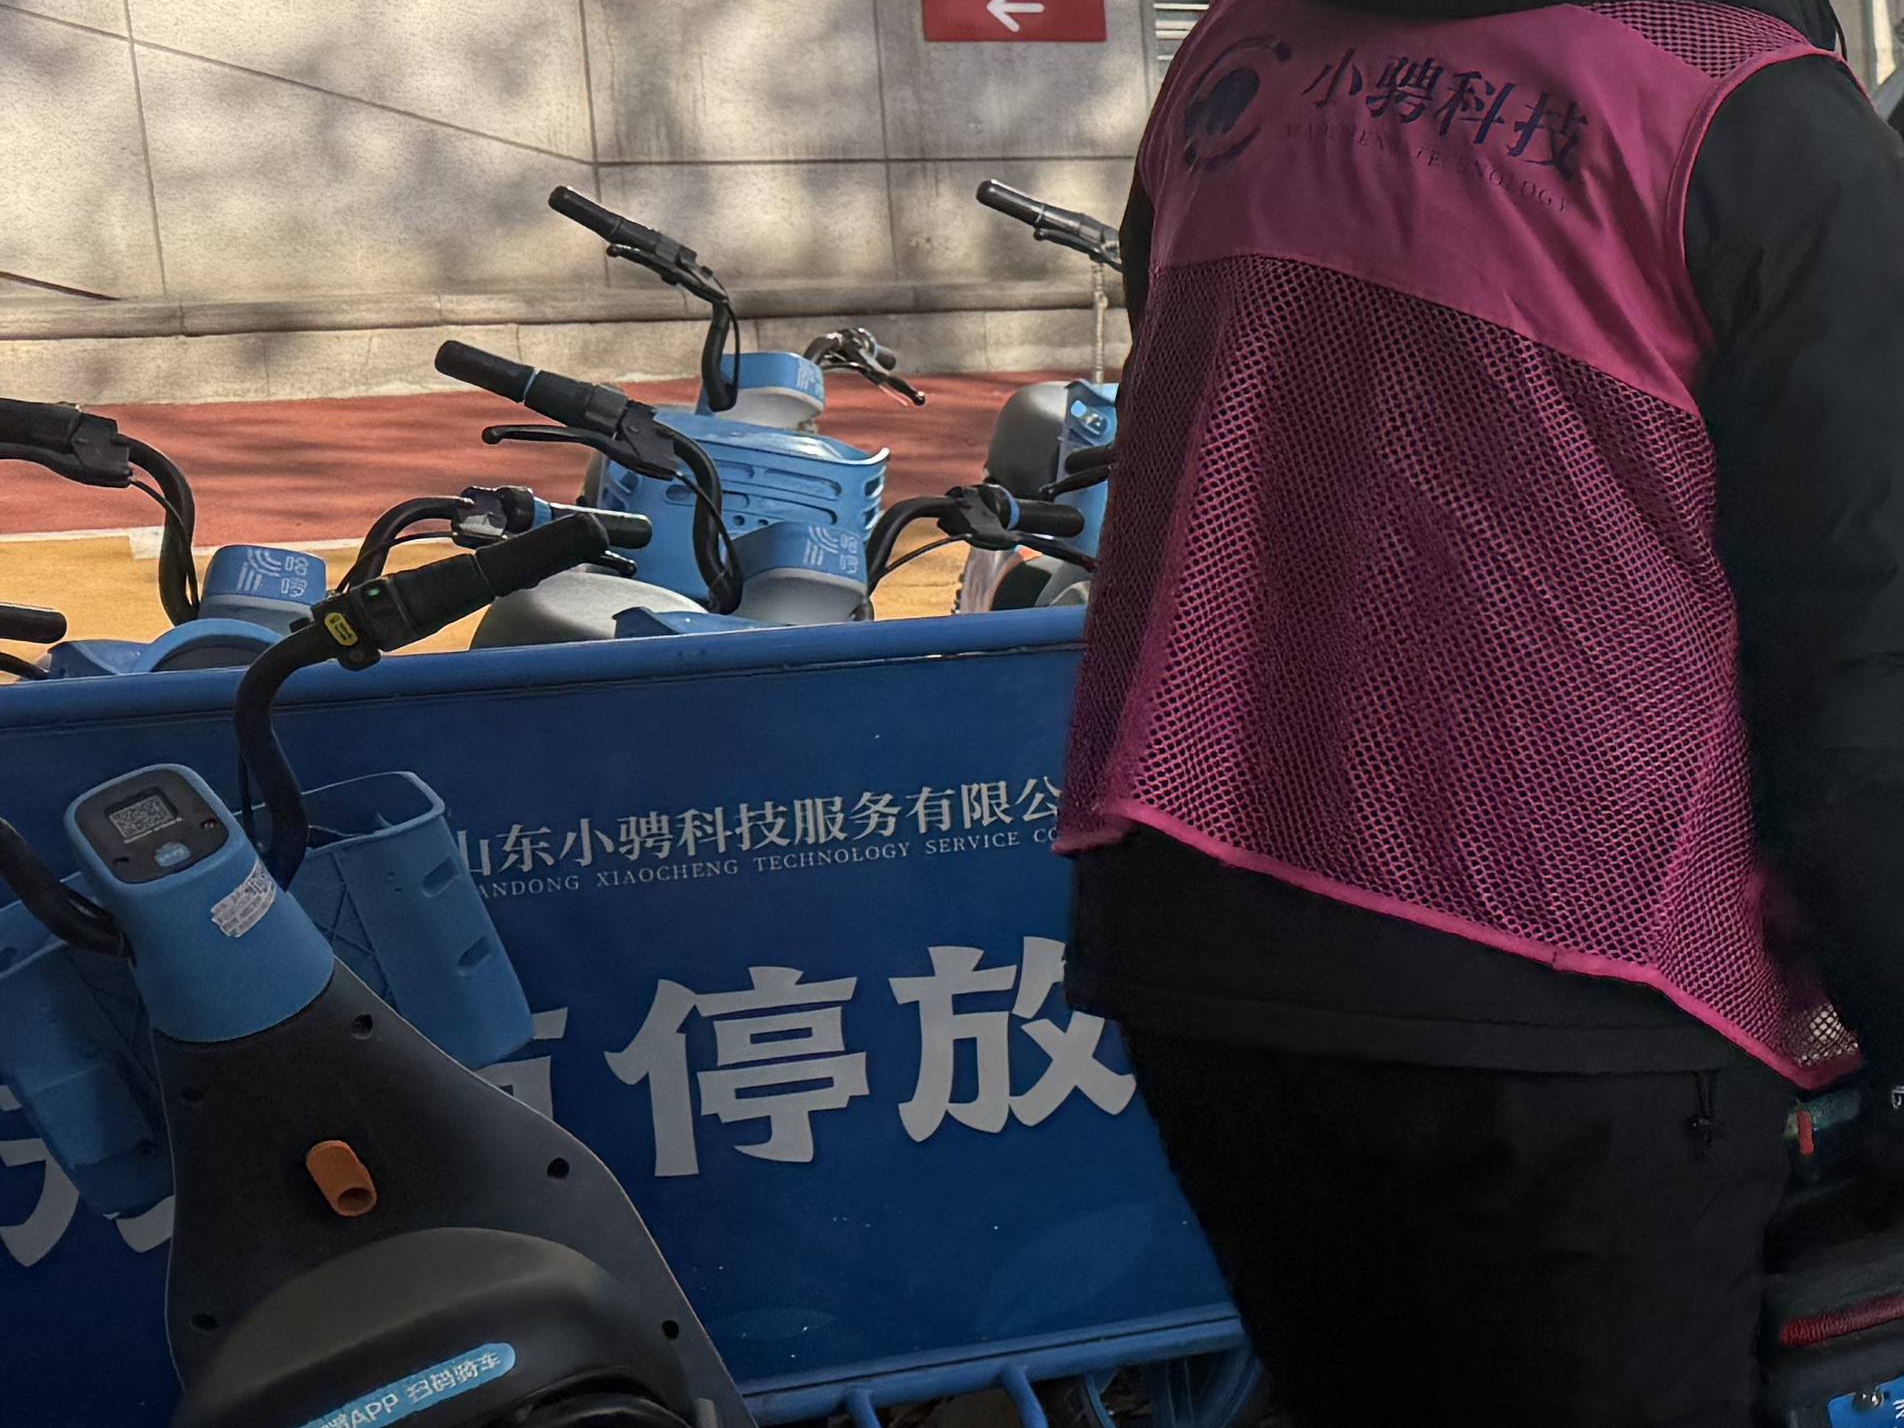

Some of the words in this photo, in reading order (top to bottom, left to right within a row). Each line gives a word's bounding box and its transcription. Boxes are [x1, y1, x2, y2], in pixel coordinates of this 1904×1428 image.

[596, 859, 739, 888] XIAOCHENG
[753, 841, 911, 873] TECHNOLOGY
[925, 831, 1021, 855] SERVICE
